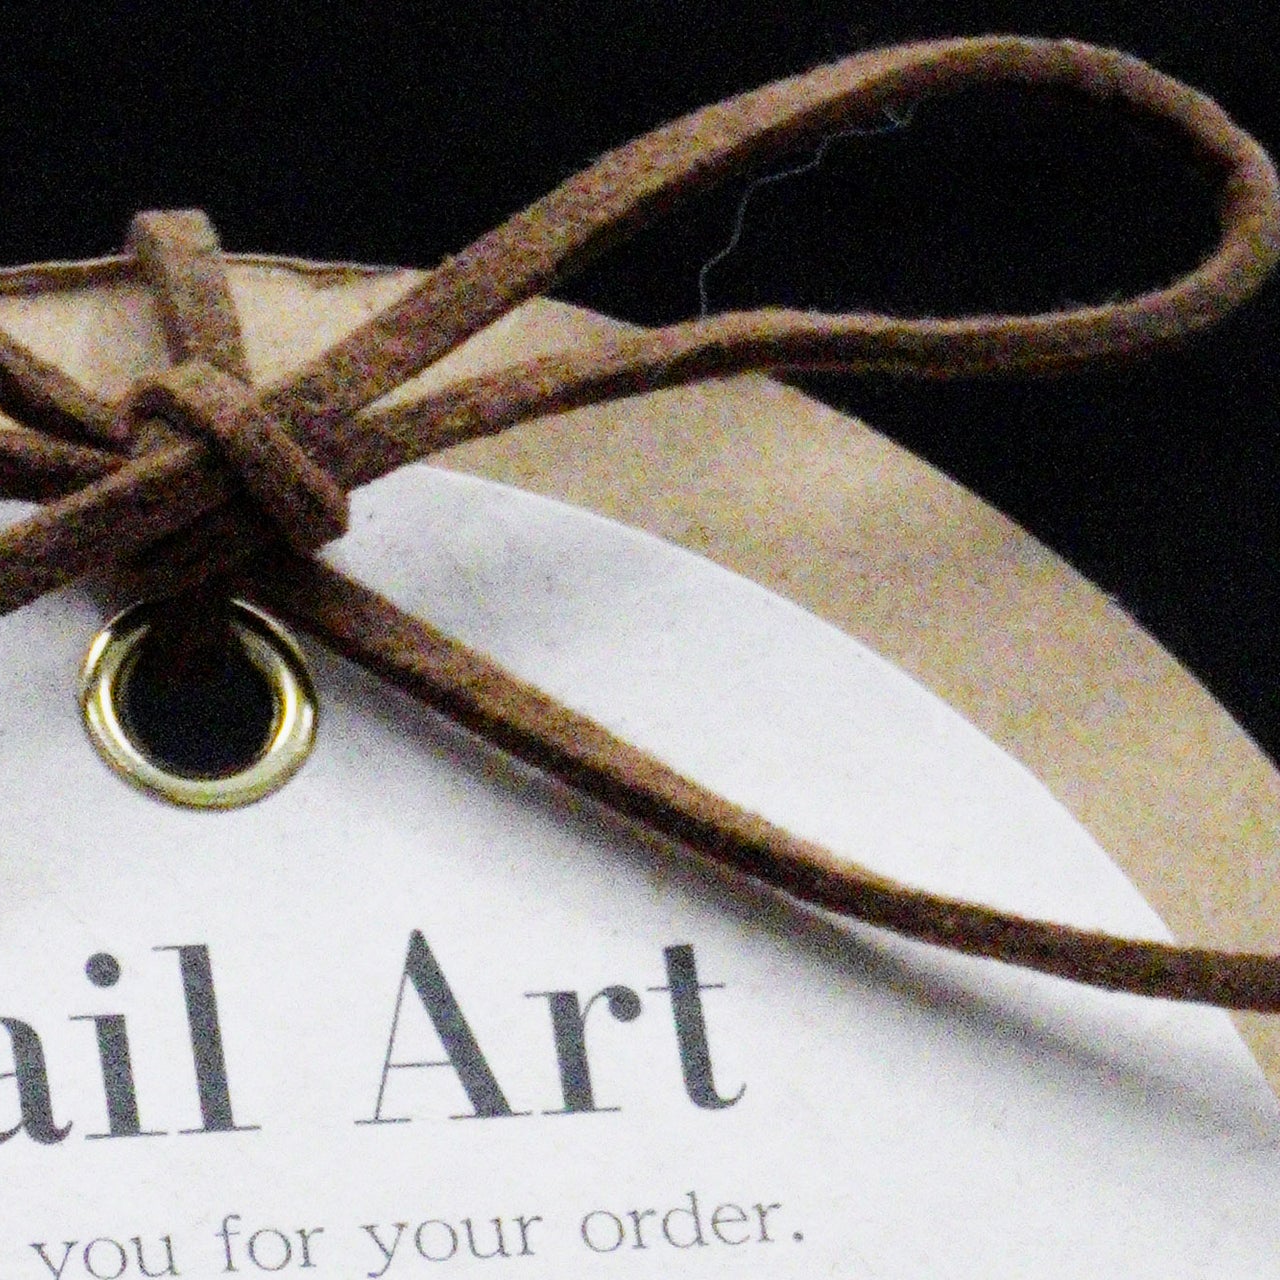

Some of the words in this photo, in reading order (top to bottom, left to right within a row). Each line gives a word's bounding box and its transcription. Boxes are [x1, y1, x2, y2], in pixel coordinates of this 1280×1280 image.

[352, 928, 748, 1125] Art
[215, 1213, 325, 1273] for
[360, 1214, 545, 1280] your
[579, 1190, 805, 1253] order.
